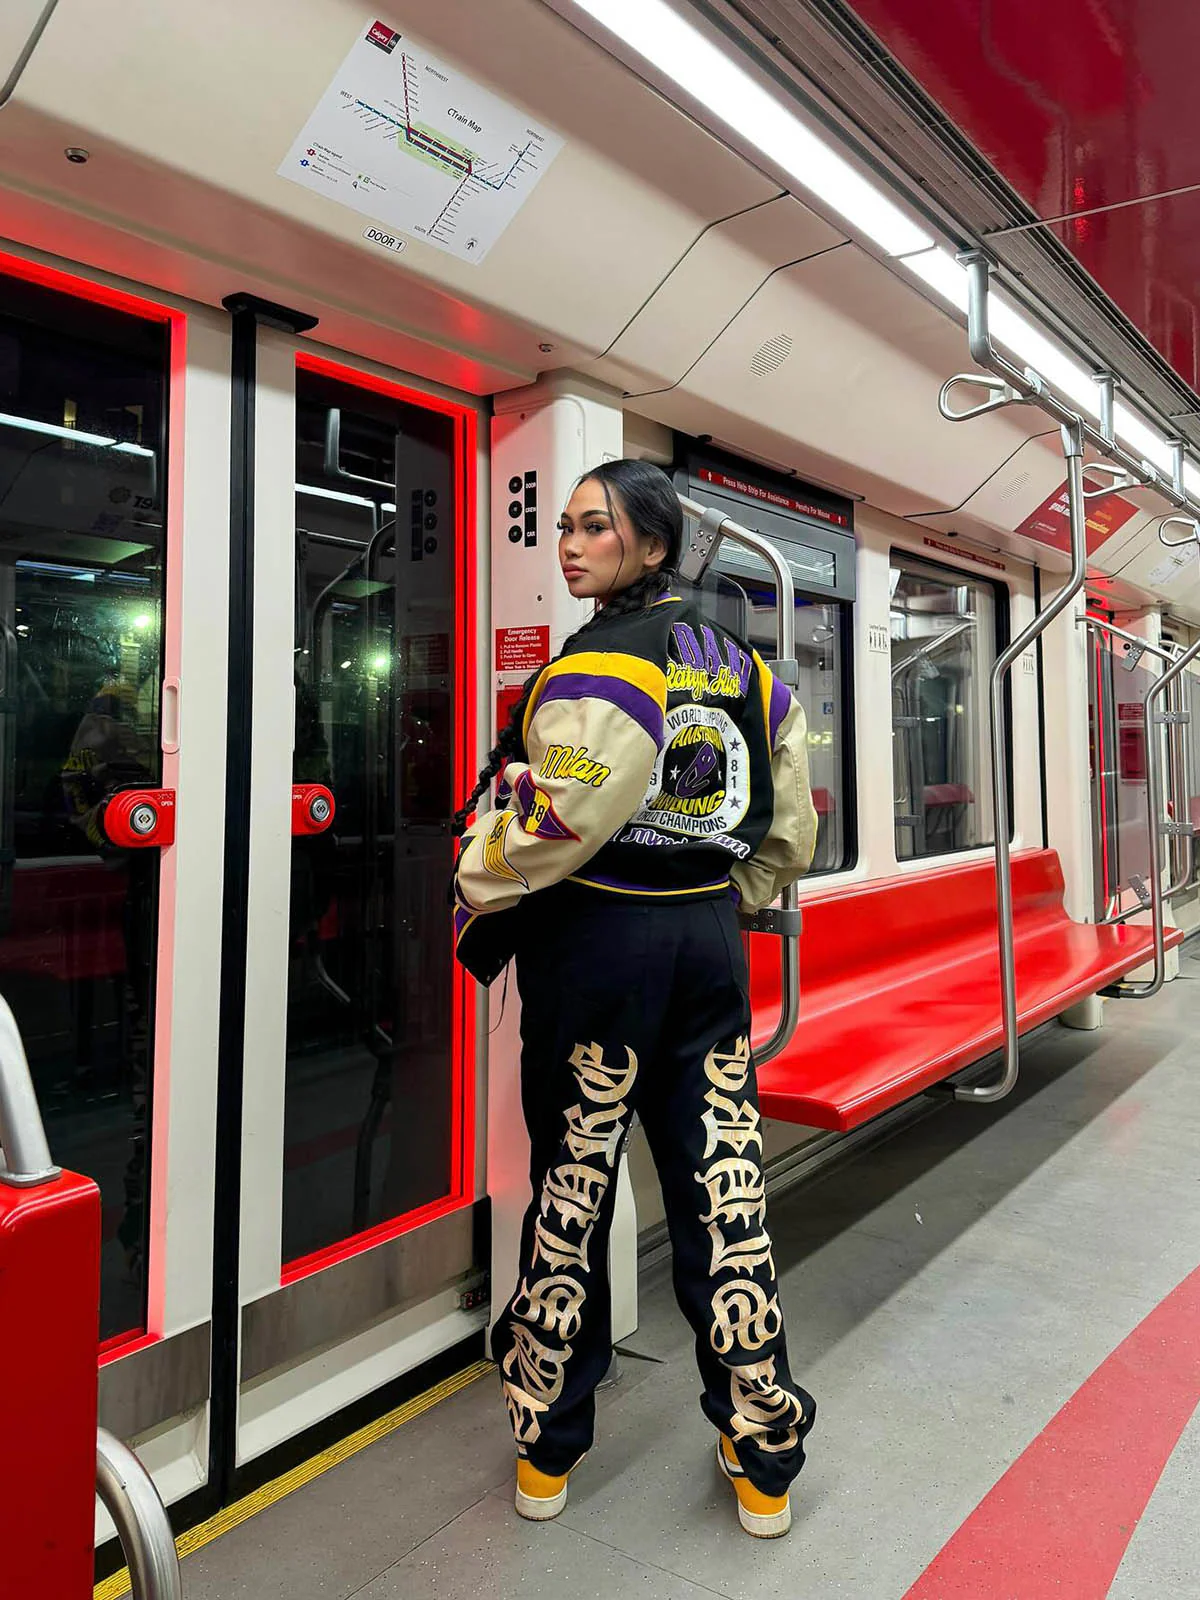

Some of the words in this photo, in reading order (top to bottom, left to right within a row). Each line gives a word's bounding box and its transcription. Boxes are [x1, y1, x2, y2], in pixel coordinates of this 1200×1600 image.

[425, 65, 449, 83] NORTHWEST
[340, 90, 353, 100] WEST
[447, 108, 469, 126] CTrain
[467, 119, 482, 134] Map
[367, 229, 395, 247] DOOR
[395, 242, 402, 250] 1
[723, 476, 736, 488] Press
[736, 480, 748, 492] Help
[747, 484, 759, 496] Strip
[759, 488, 767, 498] For
[767, 491, 790, 506] Assistance
[666, 708, 702, 730] WORLD
[540, 744, 611, 788] Milan
[659, 810, 727, 834] CHAMPIONS
